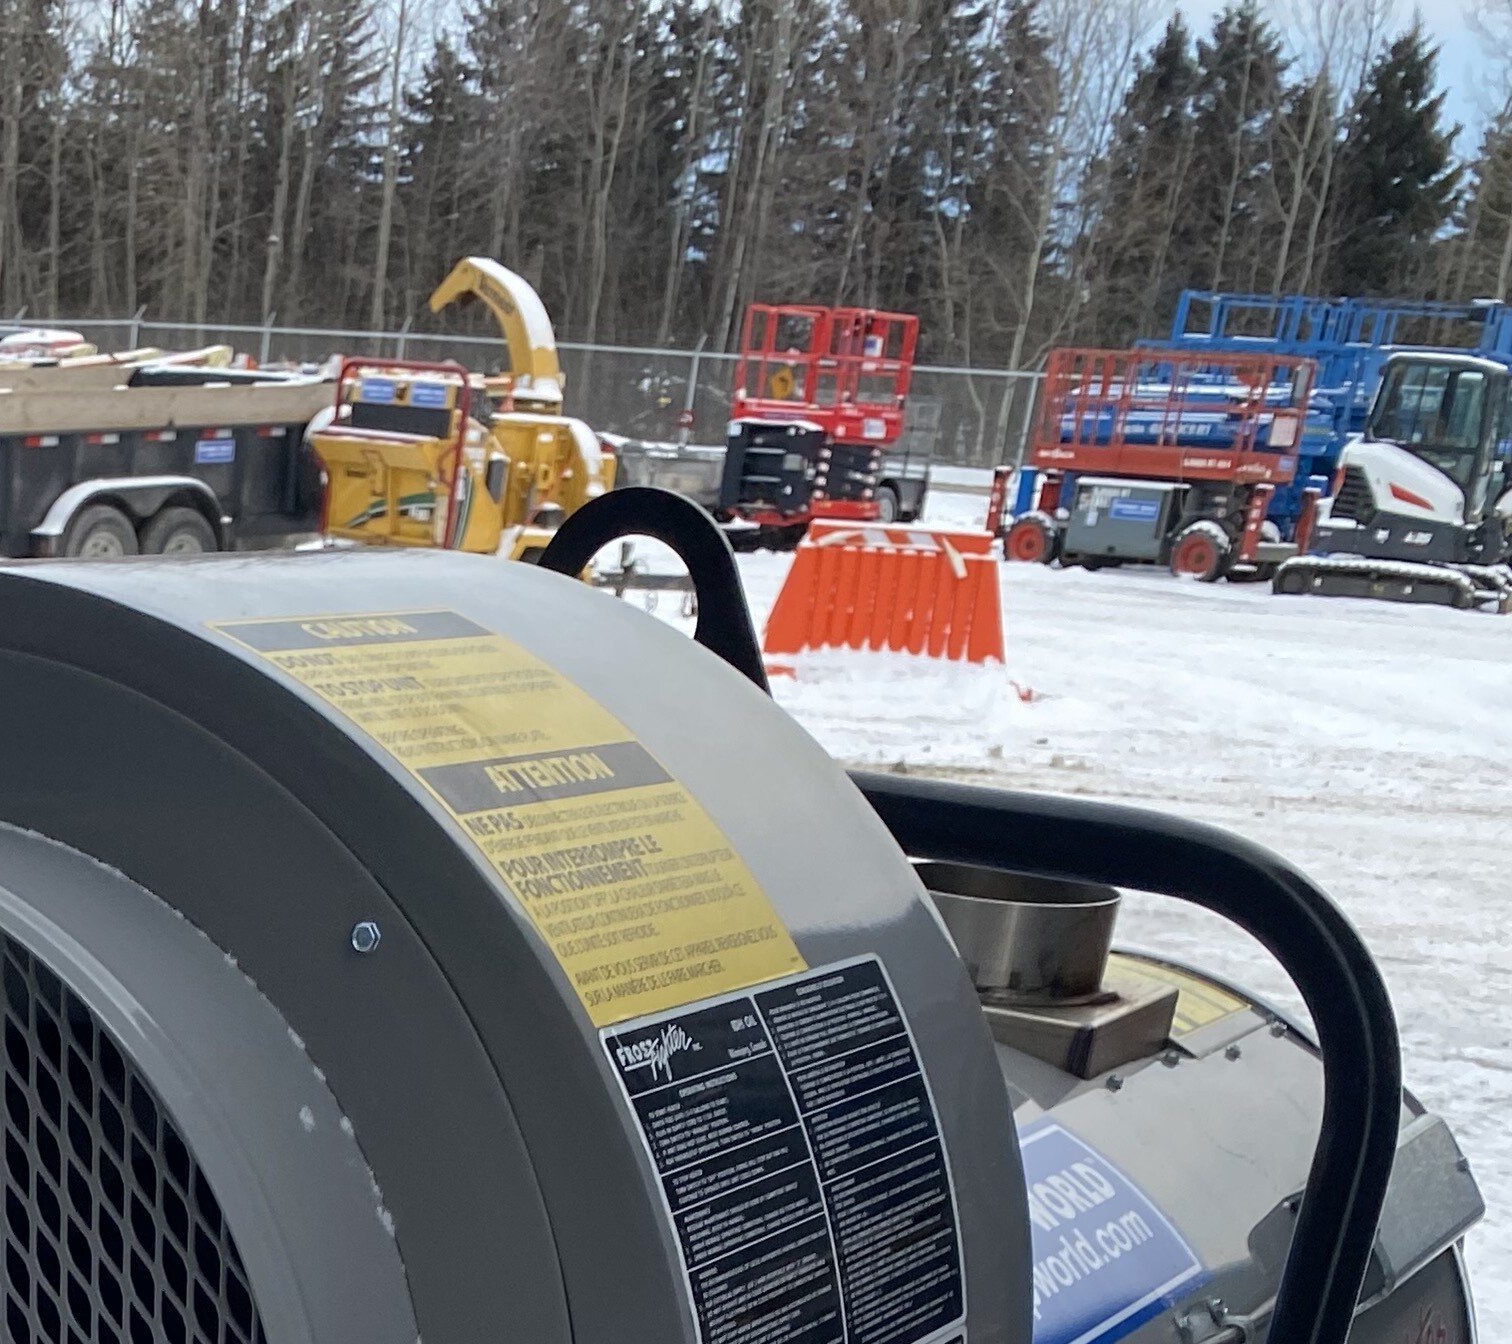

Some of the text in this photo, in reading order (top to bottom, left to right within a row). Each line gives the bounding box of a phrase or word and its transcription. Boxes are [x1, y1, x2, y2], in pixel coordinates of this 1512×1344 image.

[300, 618, 418, 641] CAUTION
[272, 655, 313, 668] DO
[300, 652, 345, 666] NOT
[337, 679, 393, 696] STOP
[484, 752, 616, 794] ATTENTION
[465, 814, 498, 838] NE
[485, 809, 526, 834] PAS
[497, 853, 551, 881] POUR
[540, 835, 647, 873] INTERROMPRE
[636, 832, 664, 854] LE
[513, 857, 653, 901] FONCTIONNEMENT
